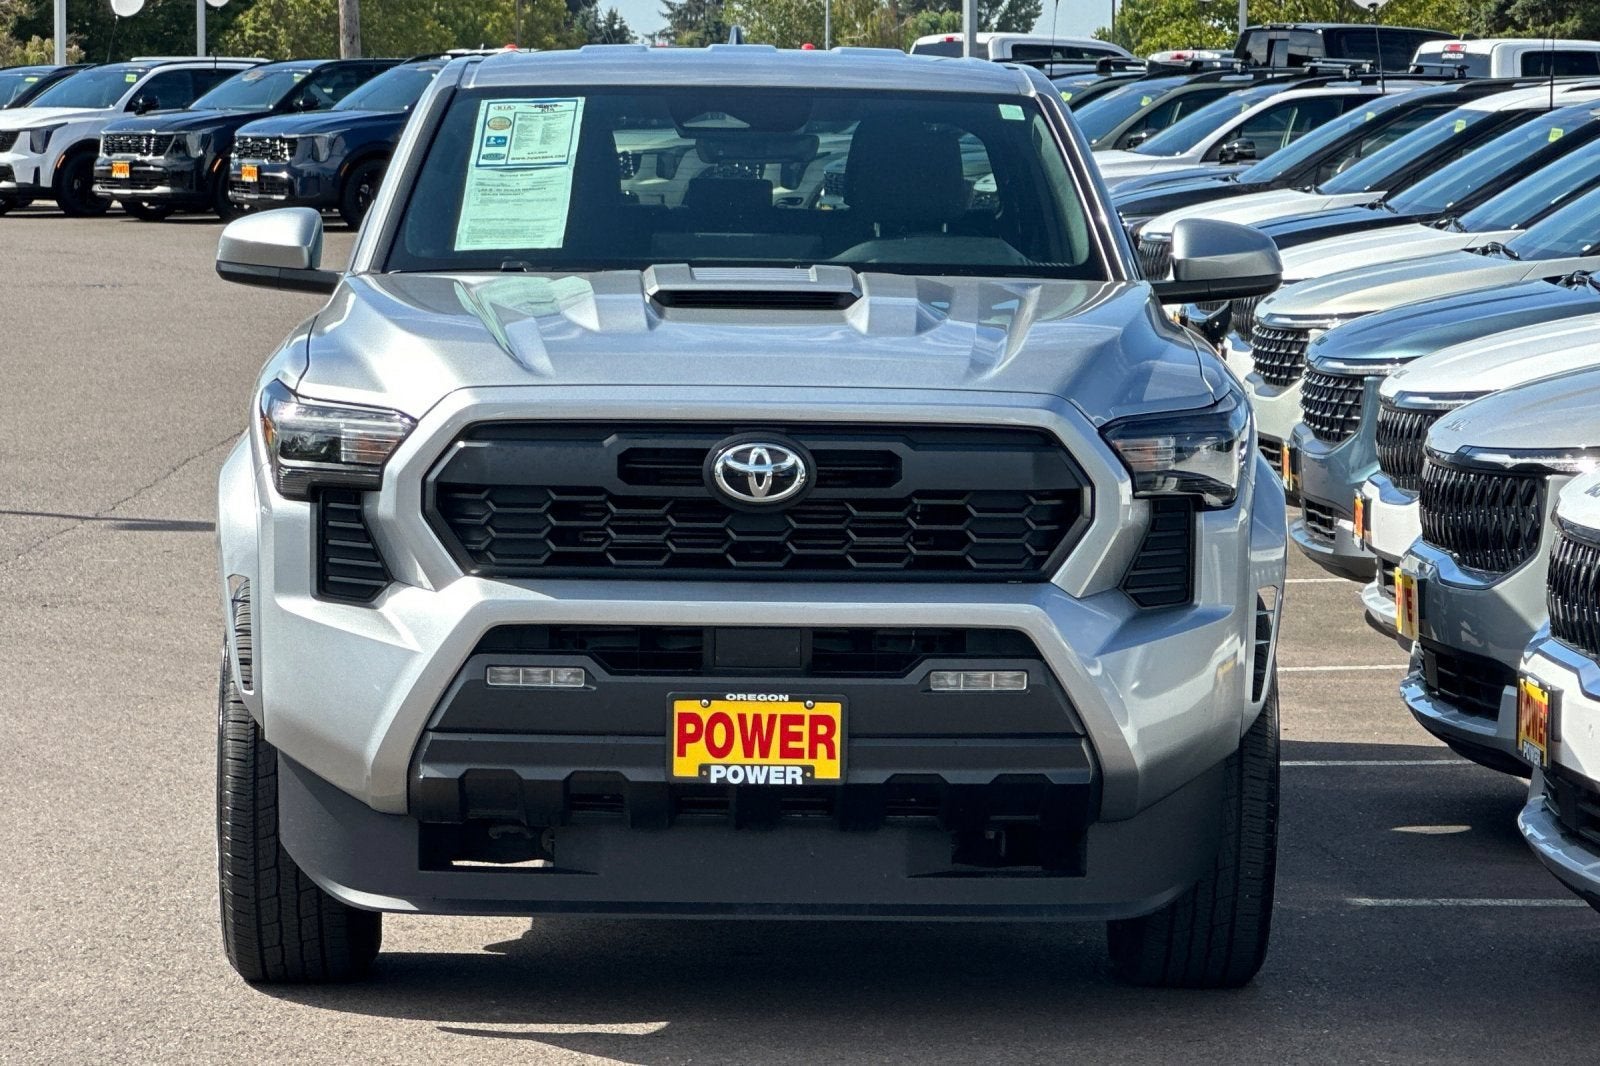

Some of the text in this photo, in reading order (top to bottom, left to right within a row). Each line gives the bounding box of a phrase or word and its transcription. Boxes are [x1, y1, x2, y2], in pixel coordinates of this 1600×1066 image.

[725, 693, 789, 702] OREGON
[676, 711, 837, 760] POWER
[710, 764, 803, 785] POWER
